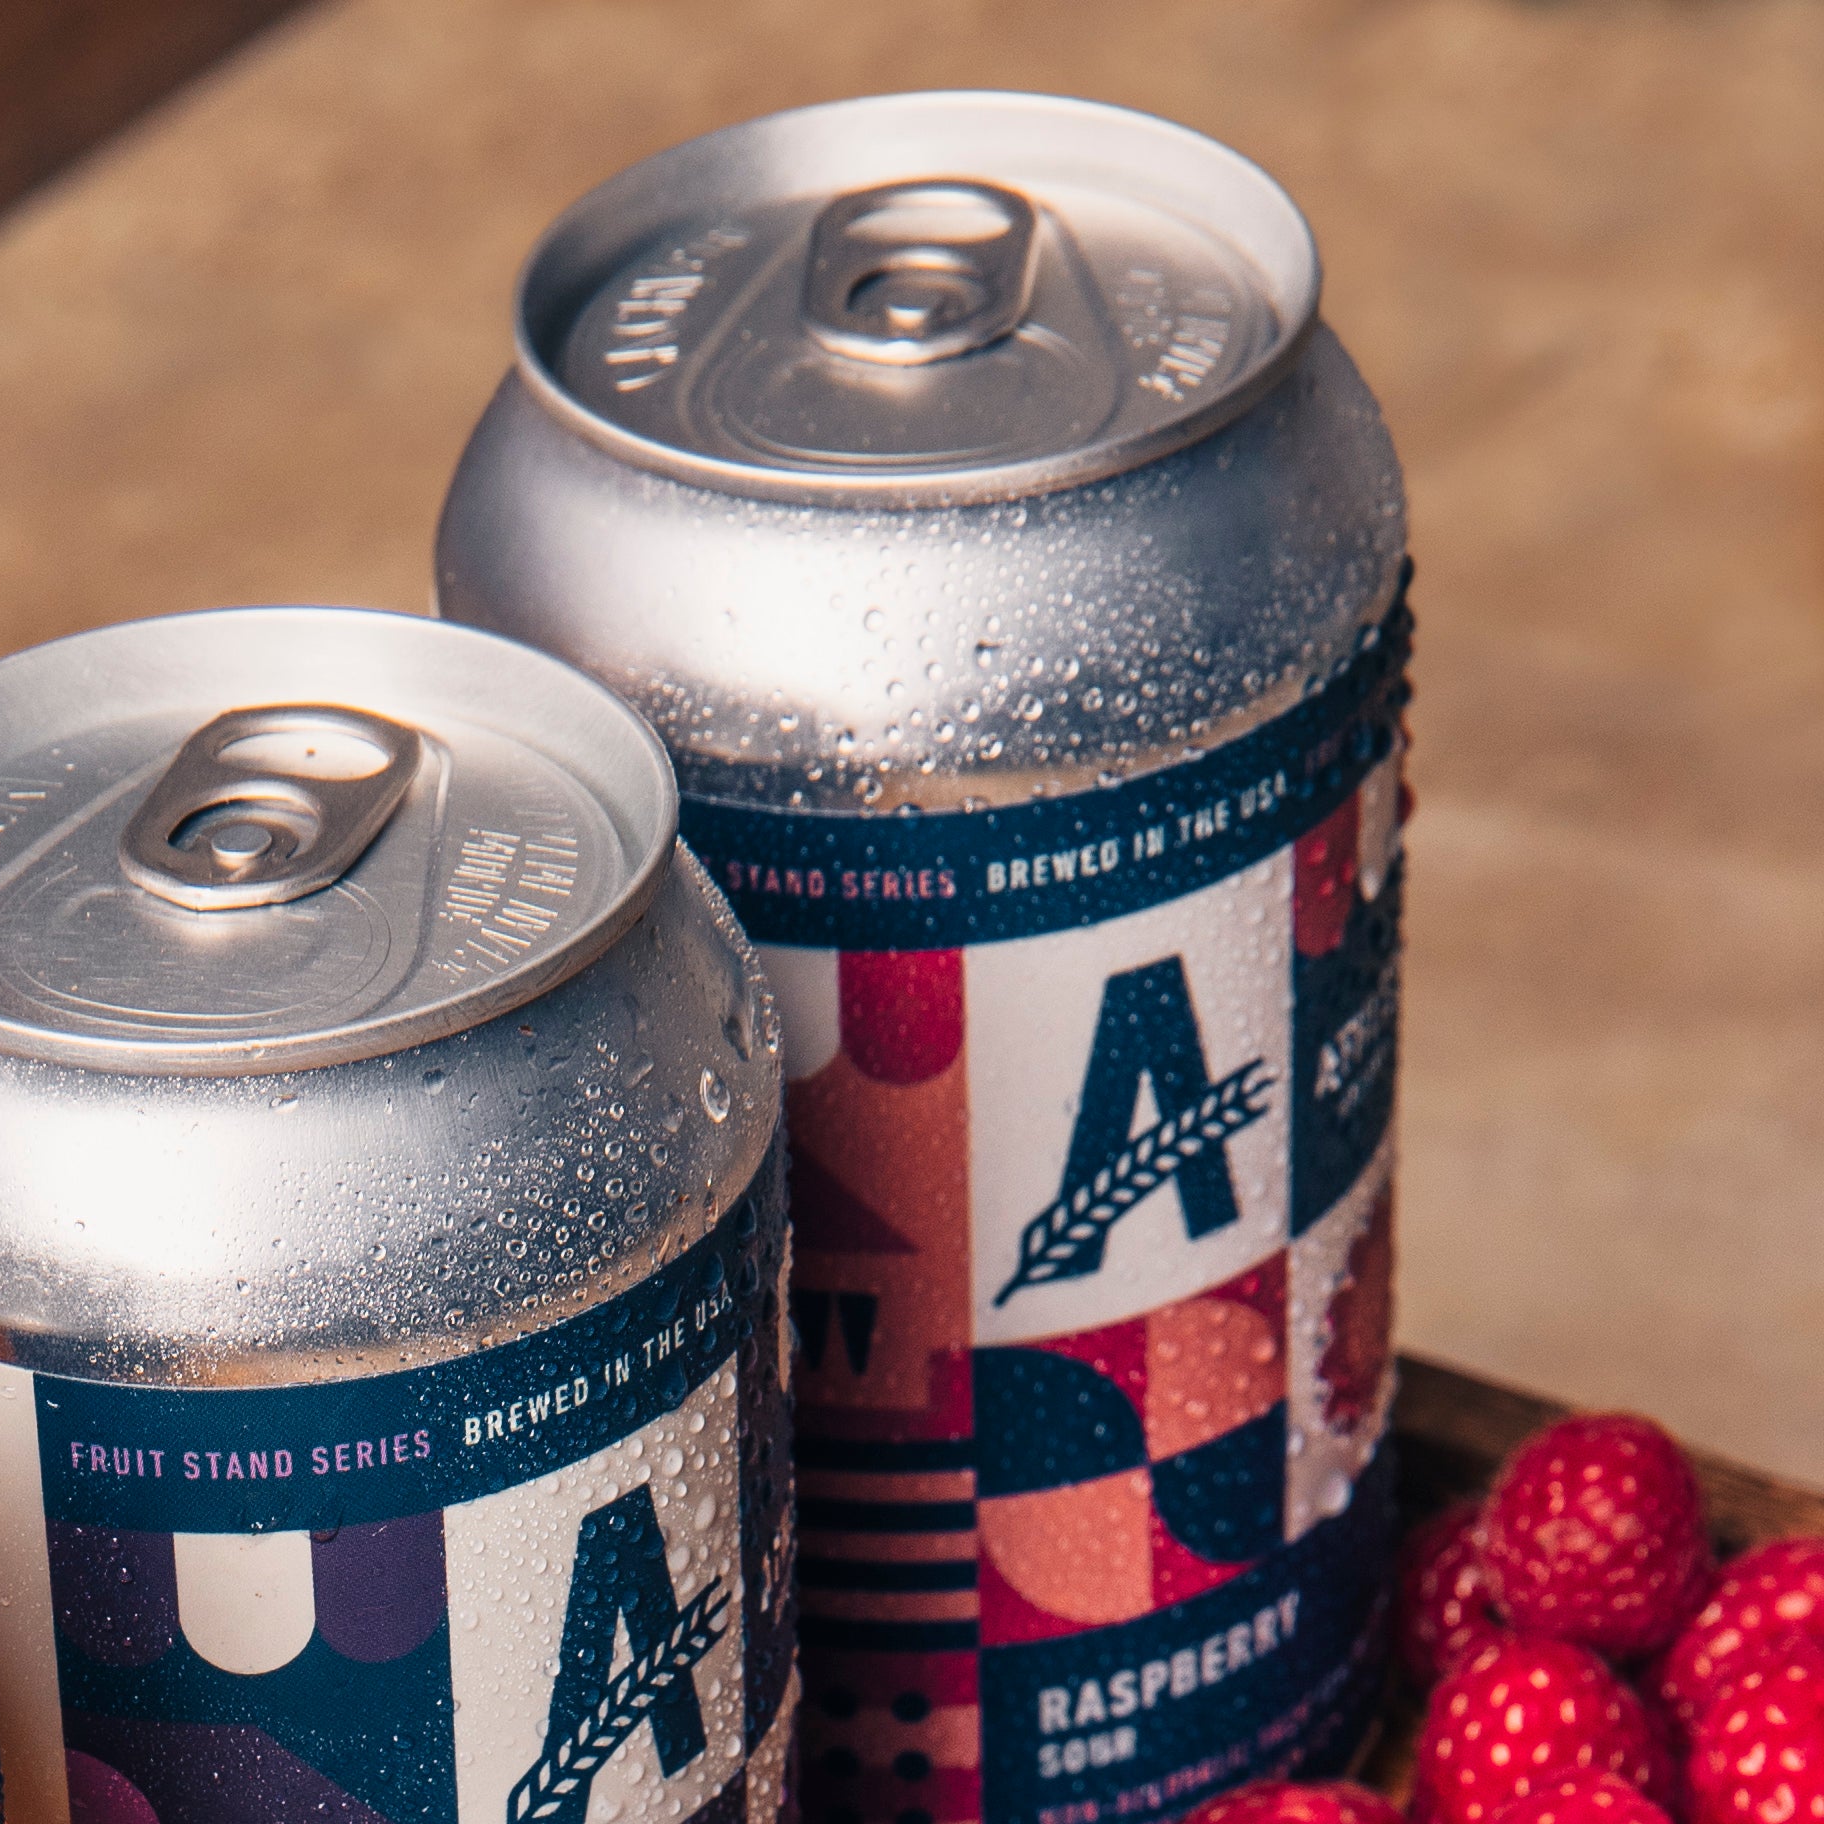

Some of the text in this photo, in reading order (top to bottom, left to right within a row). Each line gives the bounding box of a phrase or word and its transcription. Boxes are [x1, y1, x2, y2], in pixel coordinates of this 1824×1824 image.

[728, 769, 1287, 900] STAND SERIES BREWED IN THE USA
[69, 1286, 734, 1481] FRUIT STAND SERIES BREWED IN THE USA
[1037, 1587, 1301, 1736] RASPBERRY
